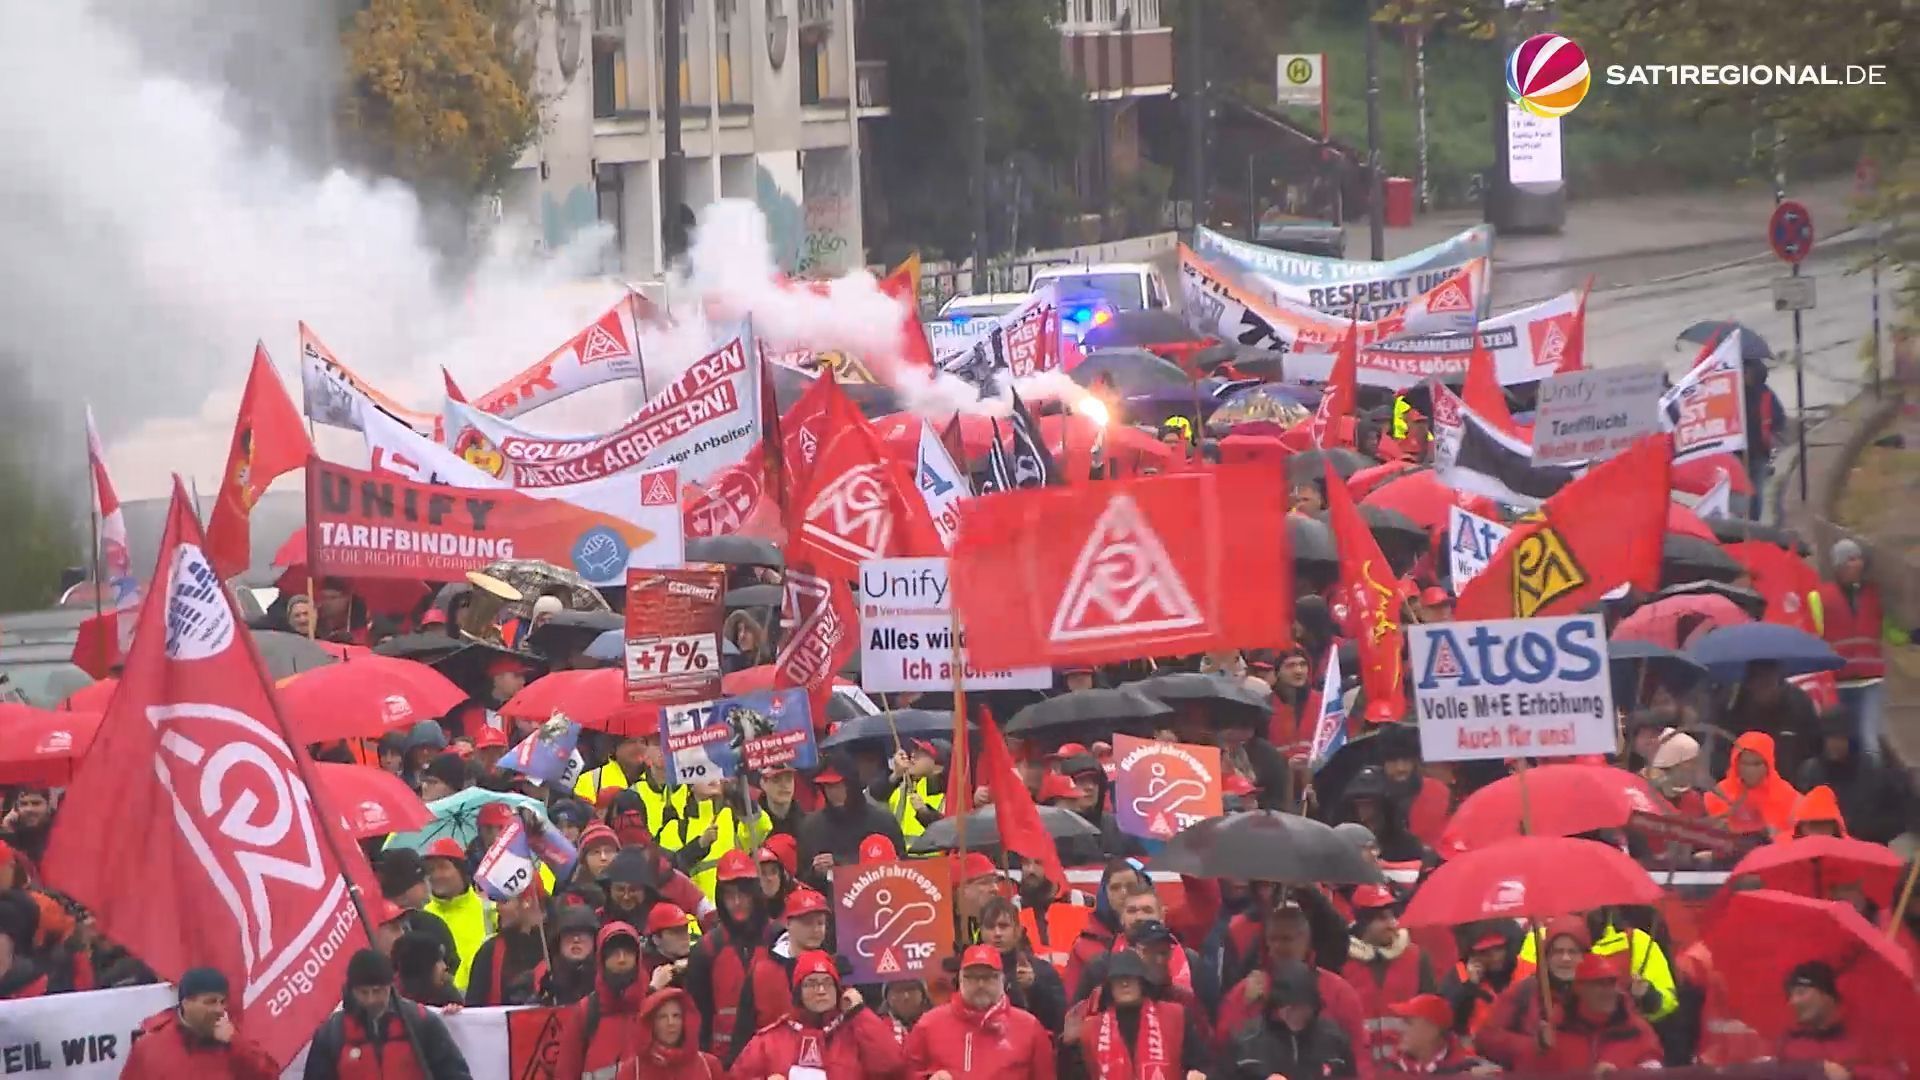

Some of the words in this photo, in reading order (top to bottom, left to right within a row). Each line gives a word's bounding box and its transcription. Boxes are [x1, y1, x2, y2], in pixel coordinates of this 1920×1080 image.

[1309, 277, 1411, 307] RESPEKT
[691, 340, 742, 388] DEN
[318, 471, 493, 531] UNIFY
[319, 522, 514, 559] TARIFBINDUNG
[864, 568, 949, 605] Unify
[870, 627, 920, 651] Alles
[636, 641, 709, 674] +7%
[902, 657, 933, 680] Ich
[1418, 620, 1601, 690] Atos
[1422, 695, 1469, 719] Volle
[1473, 693, 1513, 717] M+E
[1518, 691, 1605, 720] Erhöhung
[1457, 724, 1502, 749] Auch
[680, 764, 706, 779] 170
[503, 866, 528, 893] 170
[0, 1041, 52, 1074] EIL
[61, 1033, 118, 1067] WIR
